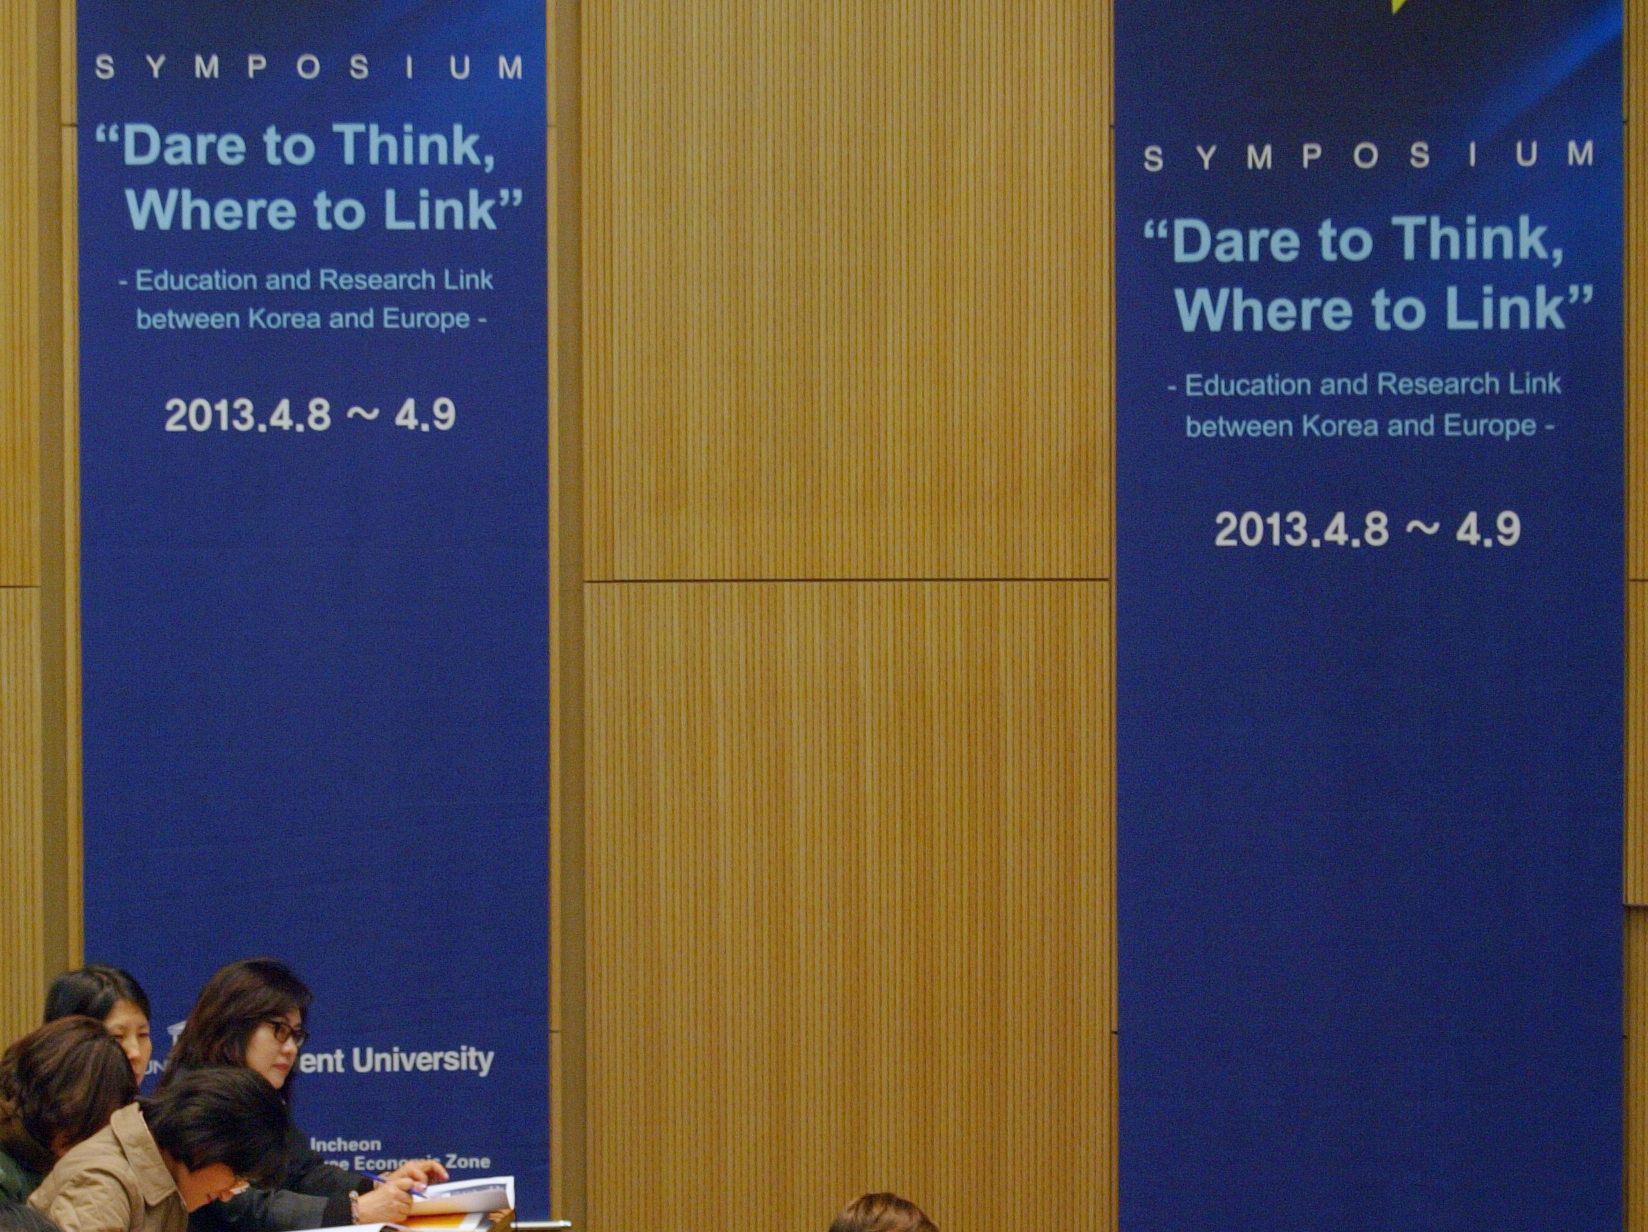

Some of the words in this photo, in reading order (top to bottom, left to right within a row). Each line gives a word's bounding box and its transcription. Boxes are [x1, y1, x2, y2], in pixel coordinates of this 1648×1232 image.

[95, 53, 523, 80] SYMPOSIUM
[95, 122, 247, 166] “Dare
[262, 124, 316, 166] to
[331, 122, 495, 174] Think,
[1143, 140, 1594, 172] SYMPOSIUM
[124, 187, 297, 231] Where
[312, 189, 366, 231] to
[384, 187, 523, 231] Link”
[1143, 217, 1301, 263] “Dare
[1317, 218, 1374, 262] to
[1390, 213, 1563, 268] Think,
[135, 268, 258, 292] Education
[265, 268, 312, 291] and
[319, 268, 436, 291] Research
[443, 268, 494, 291] Link
[136, 307, 241, 330] between
[248, 307, 322, 329] Korea
[328, 307, 375, 329] and
[382, 306, 471, 334] Europe
[1173, 286, 1353, 333] Where
[1370, 287, 1427, 332] to
[1446, 283, 1594, 331] Link”
[1185, 373, 1312, 397] Education
[1319, 372, 1368, 396] and
[1377, 371, 1500, 396] Research
[1509, 371, 1562, 395] Link
[165, 397, 332, 433] 2013.4.8
[394, 396, 456, 432] 4.9
[1185, 415, 1294, 438] between
[1302, 414, 1379, 437] Korea
[1387, 413, 1435, 437] and
[1444, 412, 1537, 441] Europe
[1215, 510, 1389, 548] 2013.4.8
[1456, 510, 1521, 548] 4.9
[299, 1047, 345, 1074] ent
[352, 1044, 495, 1078] University
[309, 1136, 382, 1153] Incheon
[445, 1153, 491, 1169] Zone
